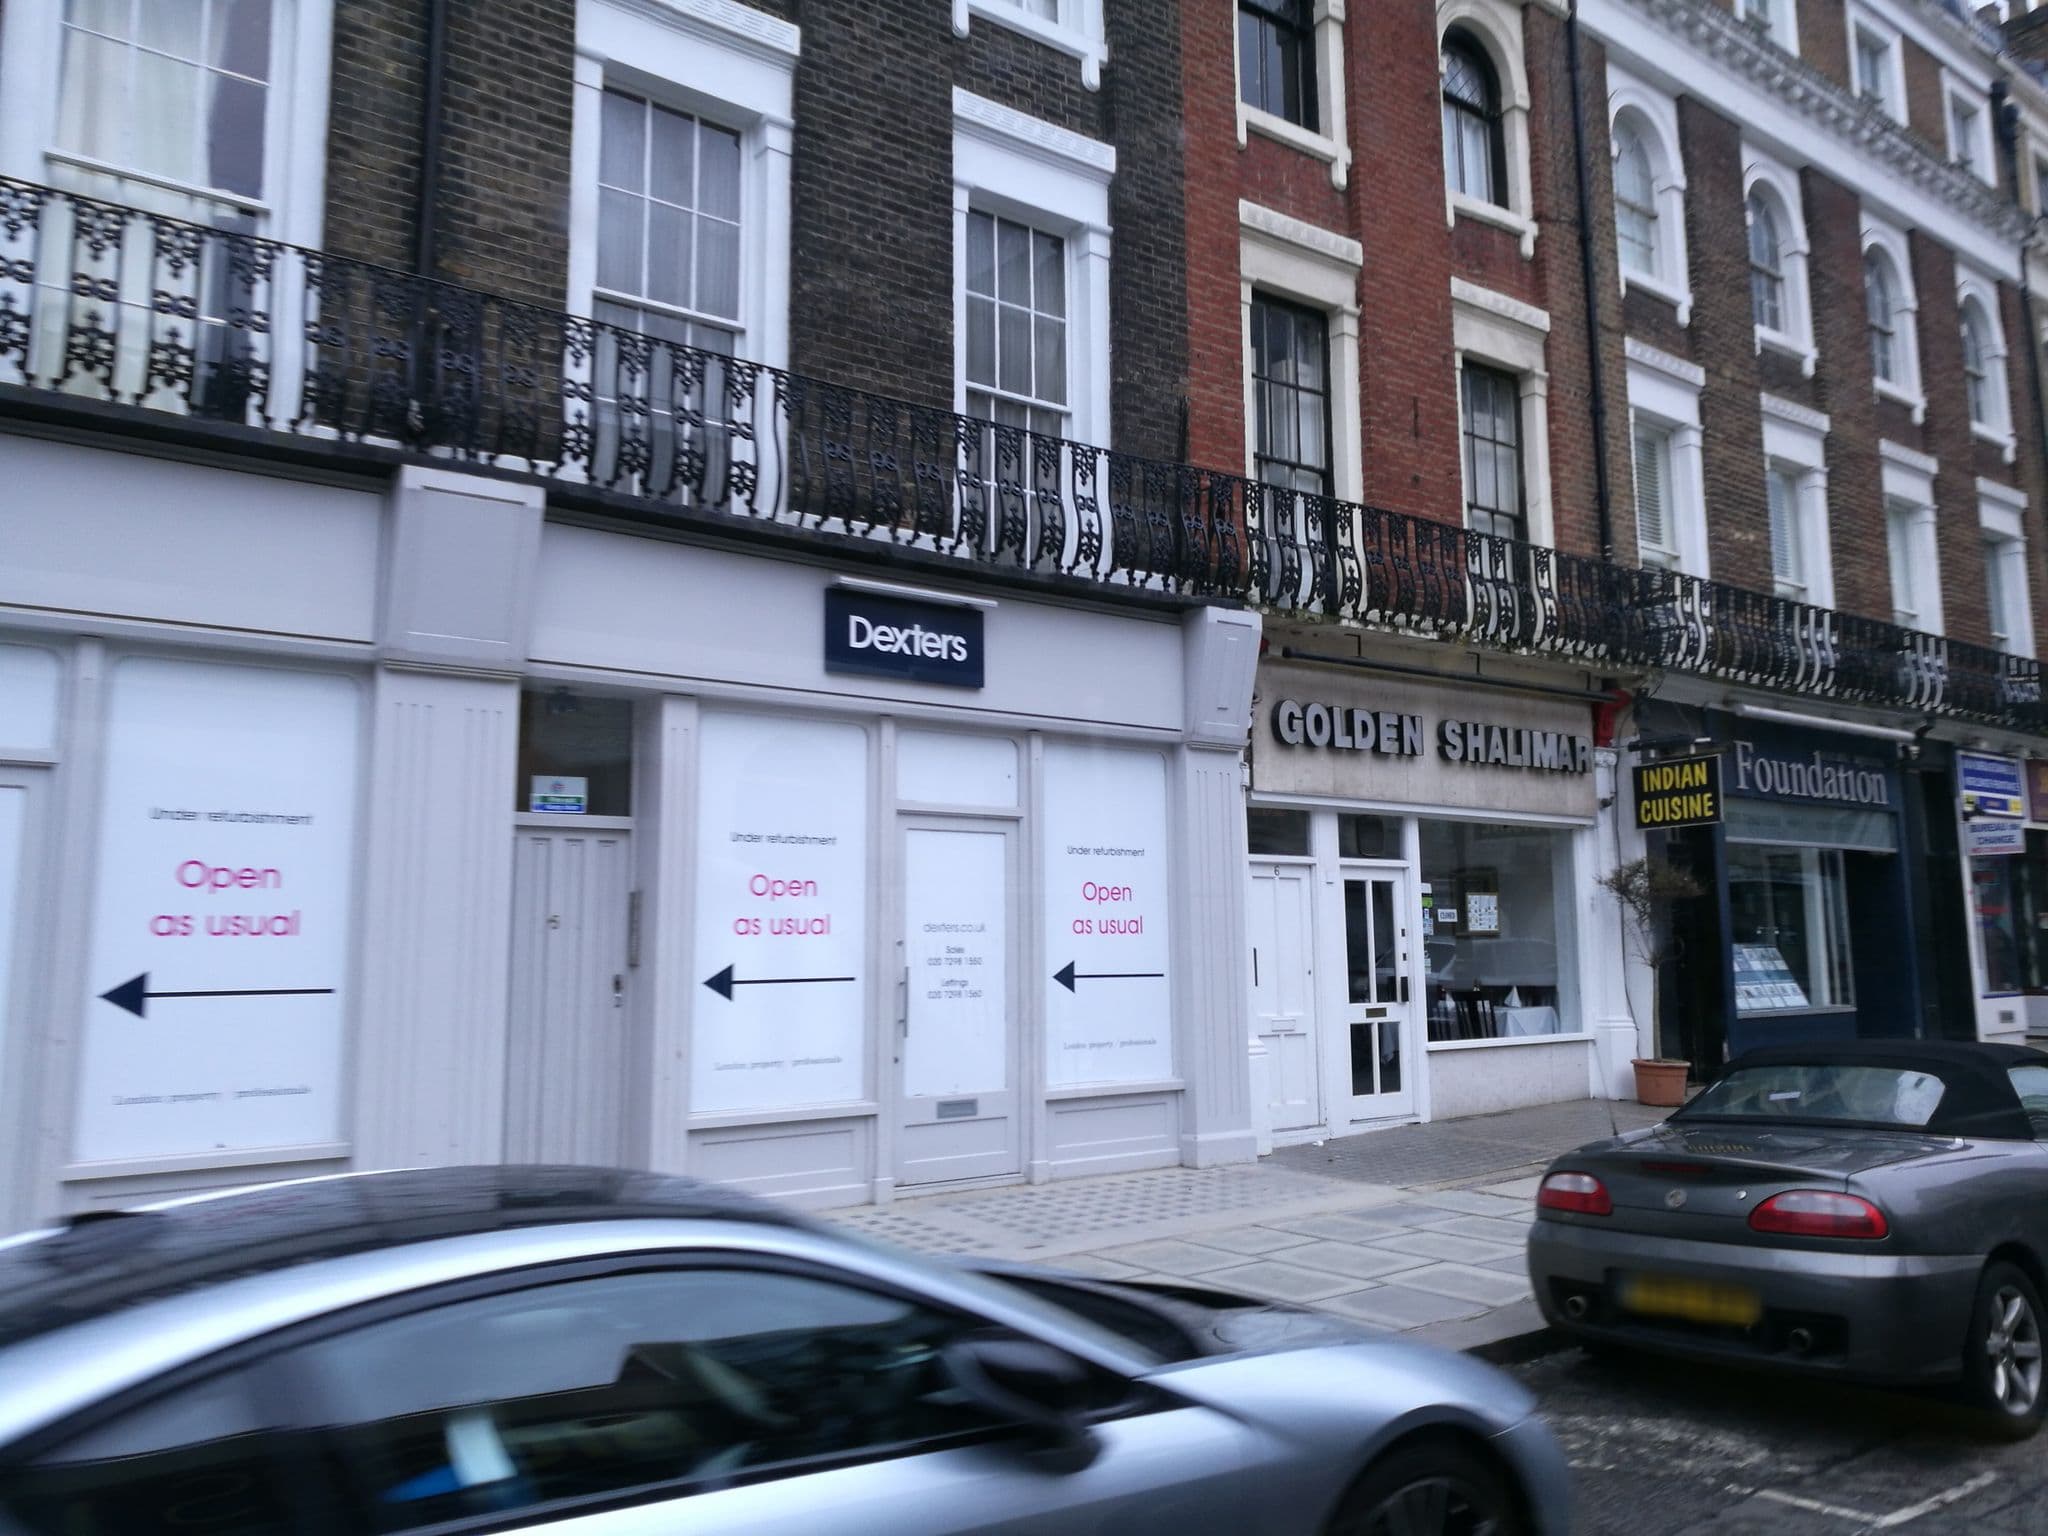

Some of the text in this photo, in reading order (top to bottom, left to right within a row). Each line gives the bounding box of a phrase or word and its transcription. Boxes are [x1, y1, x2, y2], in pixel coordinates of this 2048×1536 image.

[848, 614, 968, 662] Dexters
[1272, 700, 1593, 773] GOLDEN SHALIMAR
[1642, 761, 1708, 793] INDIAN
[1735, 740, 1890, 806] Foundation
[1640, 793, 1714, 824] CUISINE
[1067, 845, 1145, 857] Under refurbishment
[176, 860, 282, 894] Open
[749, 874, 818, 901] Open
[1083, 881, 1132, 905] Open
[150, 910, 301, 936] as usual
[734, 914, 831, 936] as usual
[1072, 915, 1144, 934] as usual
